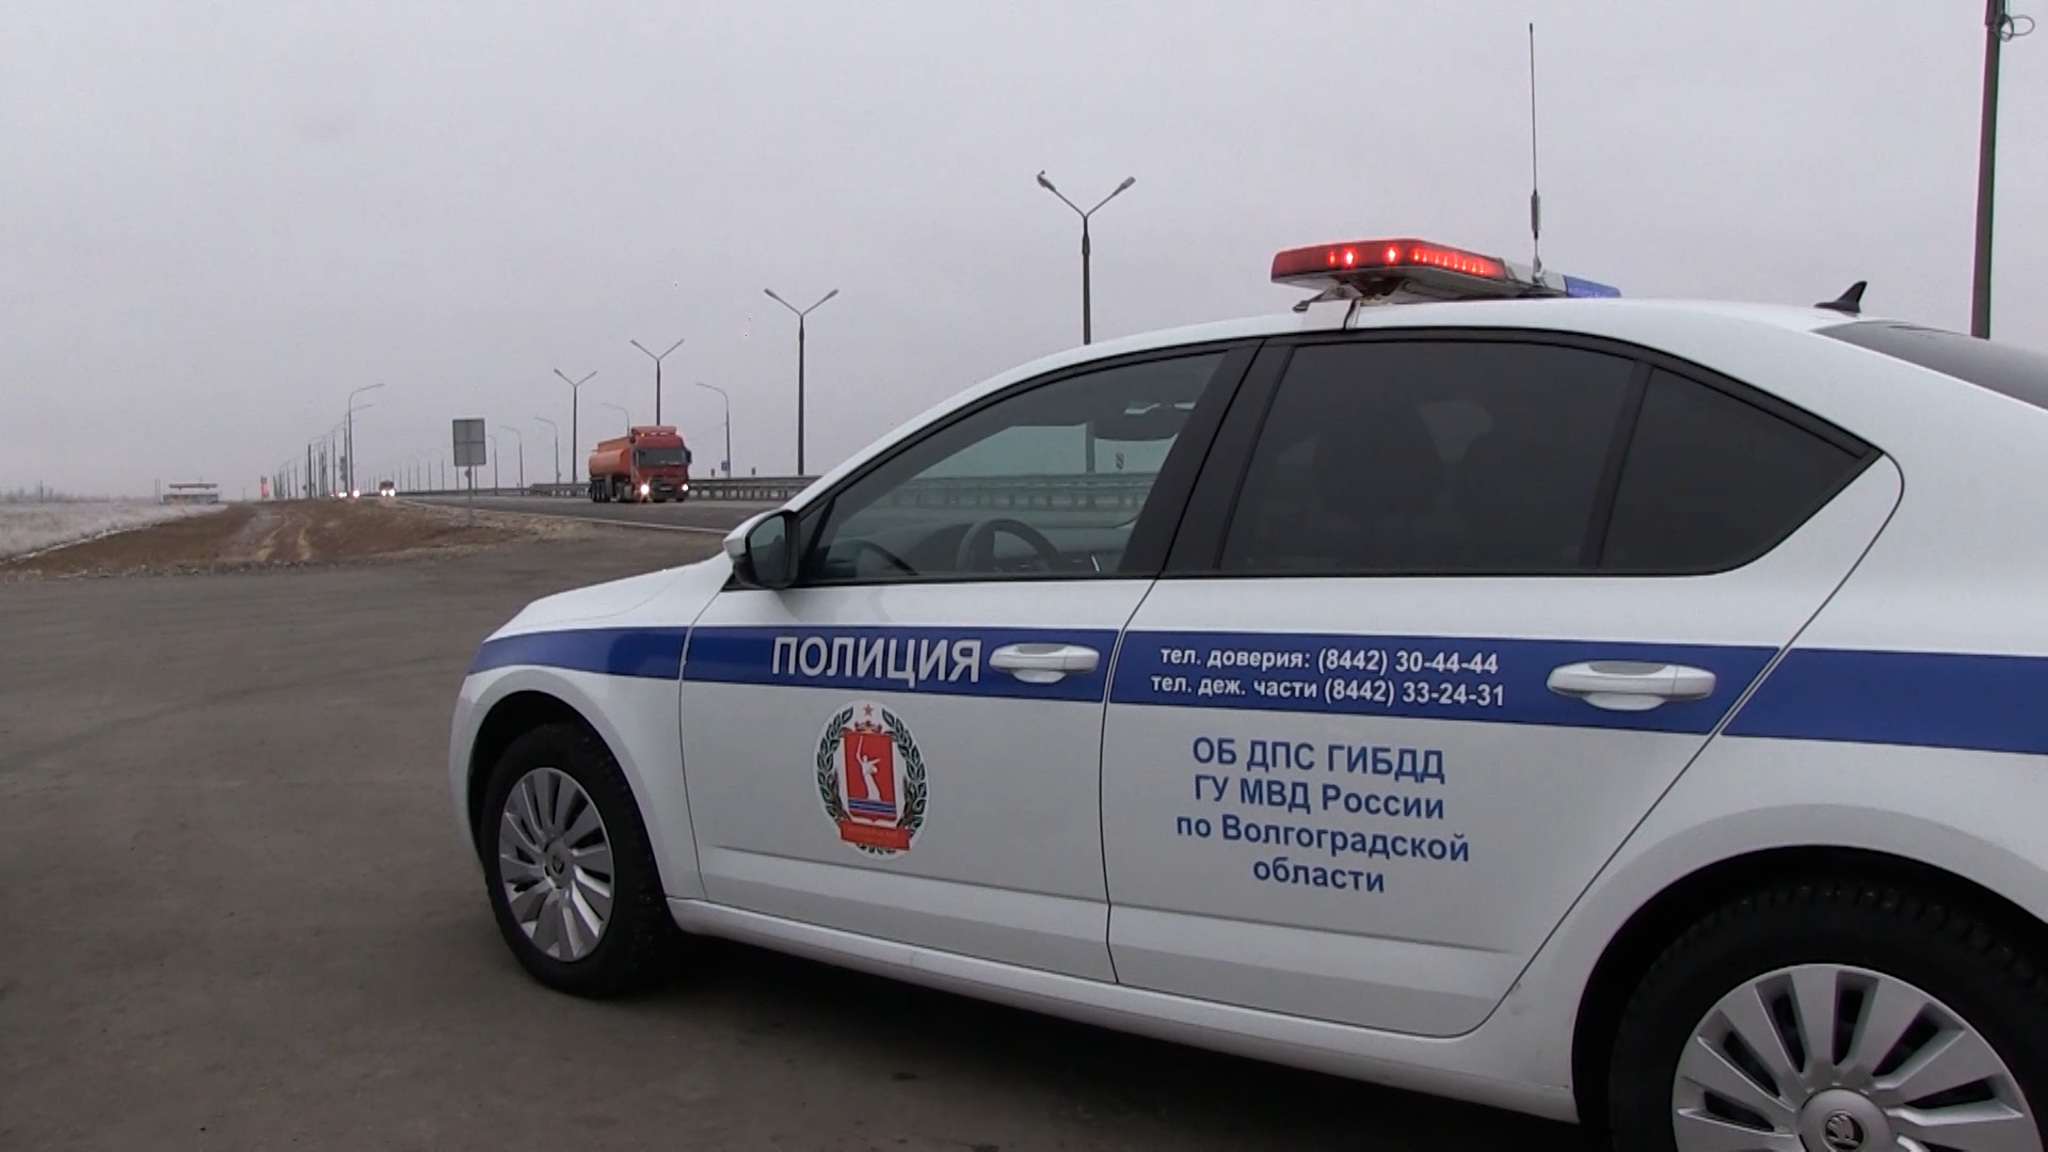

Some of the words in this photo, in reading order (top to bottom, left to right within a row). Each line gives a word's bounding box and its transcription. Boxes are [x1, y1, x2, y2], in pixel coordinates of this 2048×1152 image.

[772, 636, 982, 689] ПОЛИЦИЯ
[1160, 648, 1200, 665] тел.
[1207, 648, 1311, 672] доверия:
[1318, 648, 1389, 676] (8442)
[1395, 651, 1499, 675] 30-44-44
[1151, 675, 1191, 692] тел.
[1198, 677, 1246, 697] деж.
[1253, 680, 1318, 699] части
[1324, 678, 1395, 707] (8442)
[1402, 681, 1504, 707] 33-24-31
[1193, 737, 1238, 765] ОБ
[1247, 740, 1315, 772] ДПС
[1327, 744, 1446, 785] ГИБДД
[1194, 774, 1229, 802] ГУ
[1240, 778, 1311, 815] МВД
[1321, 784, 1445, 820] России
[1176, 815, 1212, 838] по
[1221, 814, 1470, 863] Волгоградской
[1253, 857, 1385, 893] области
